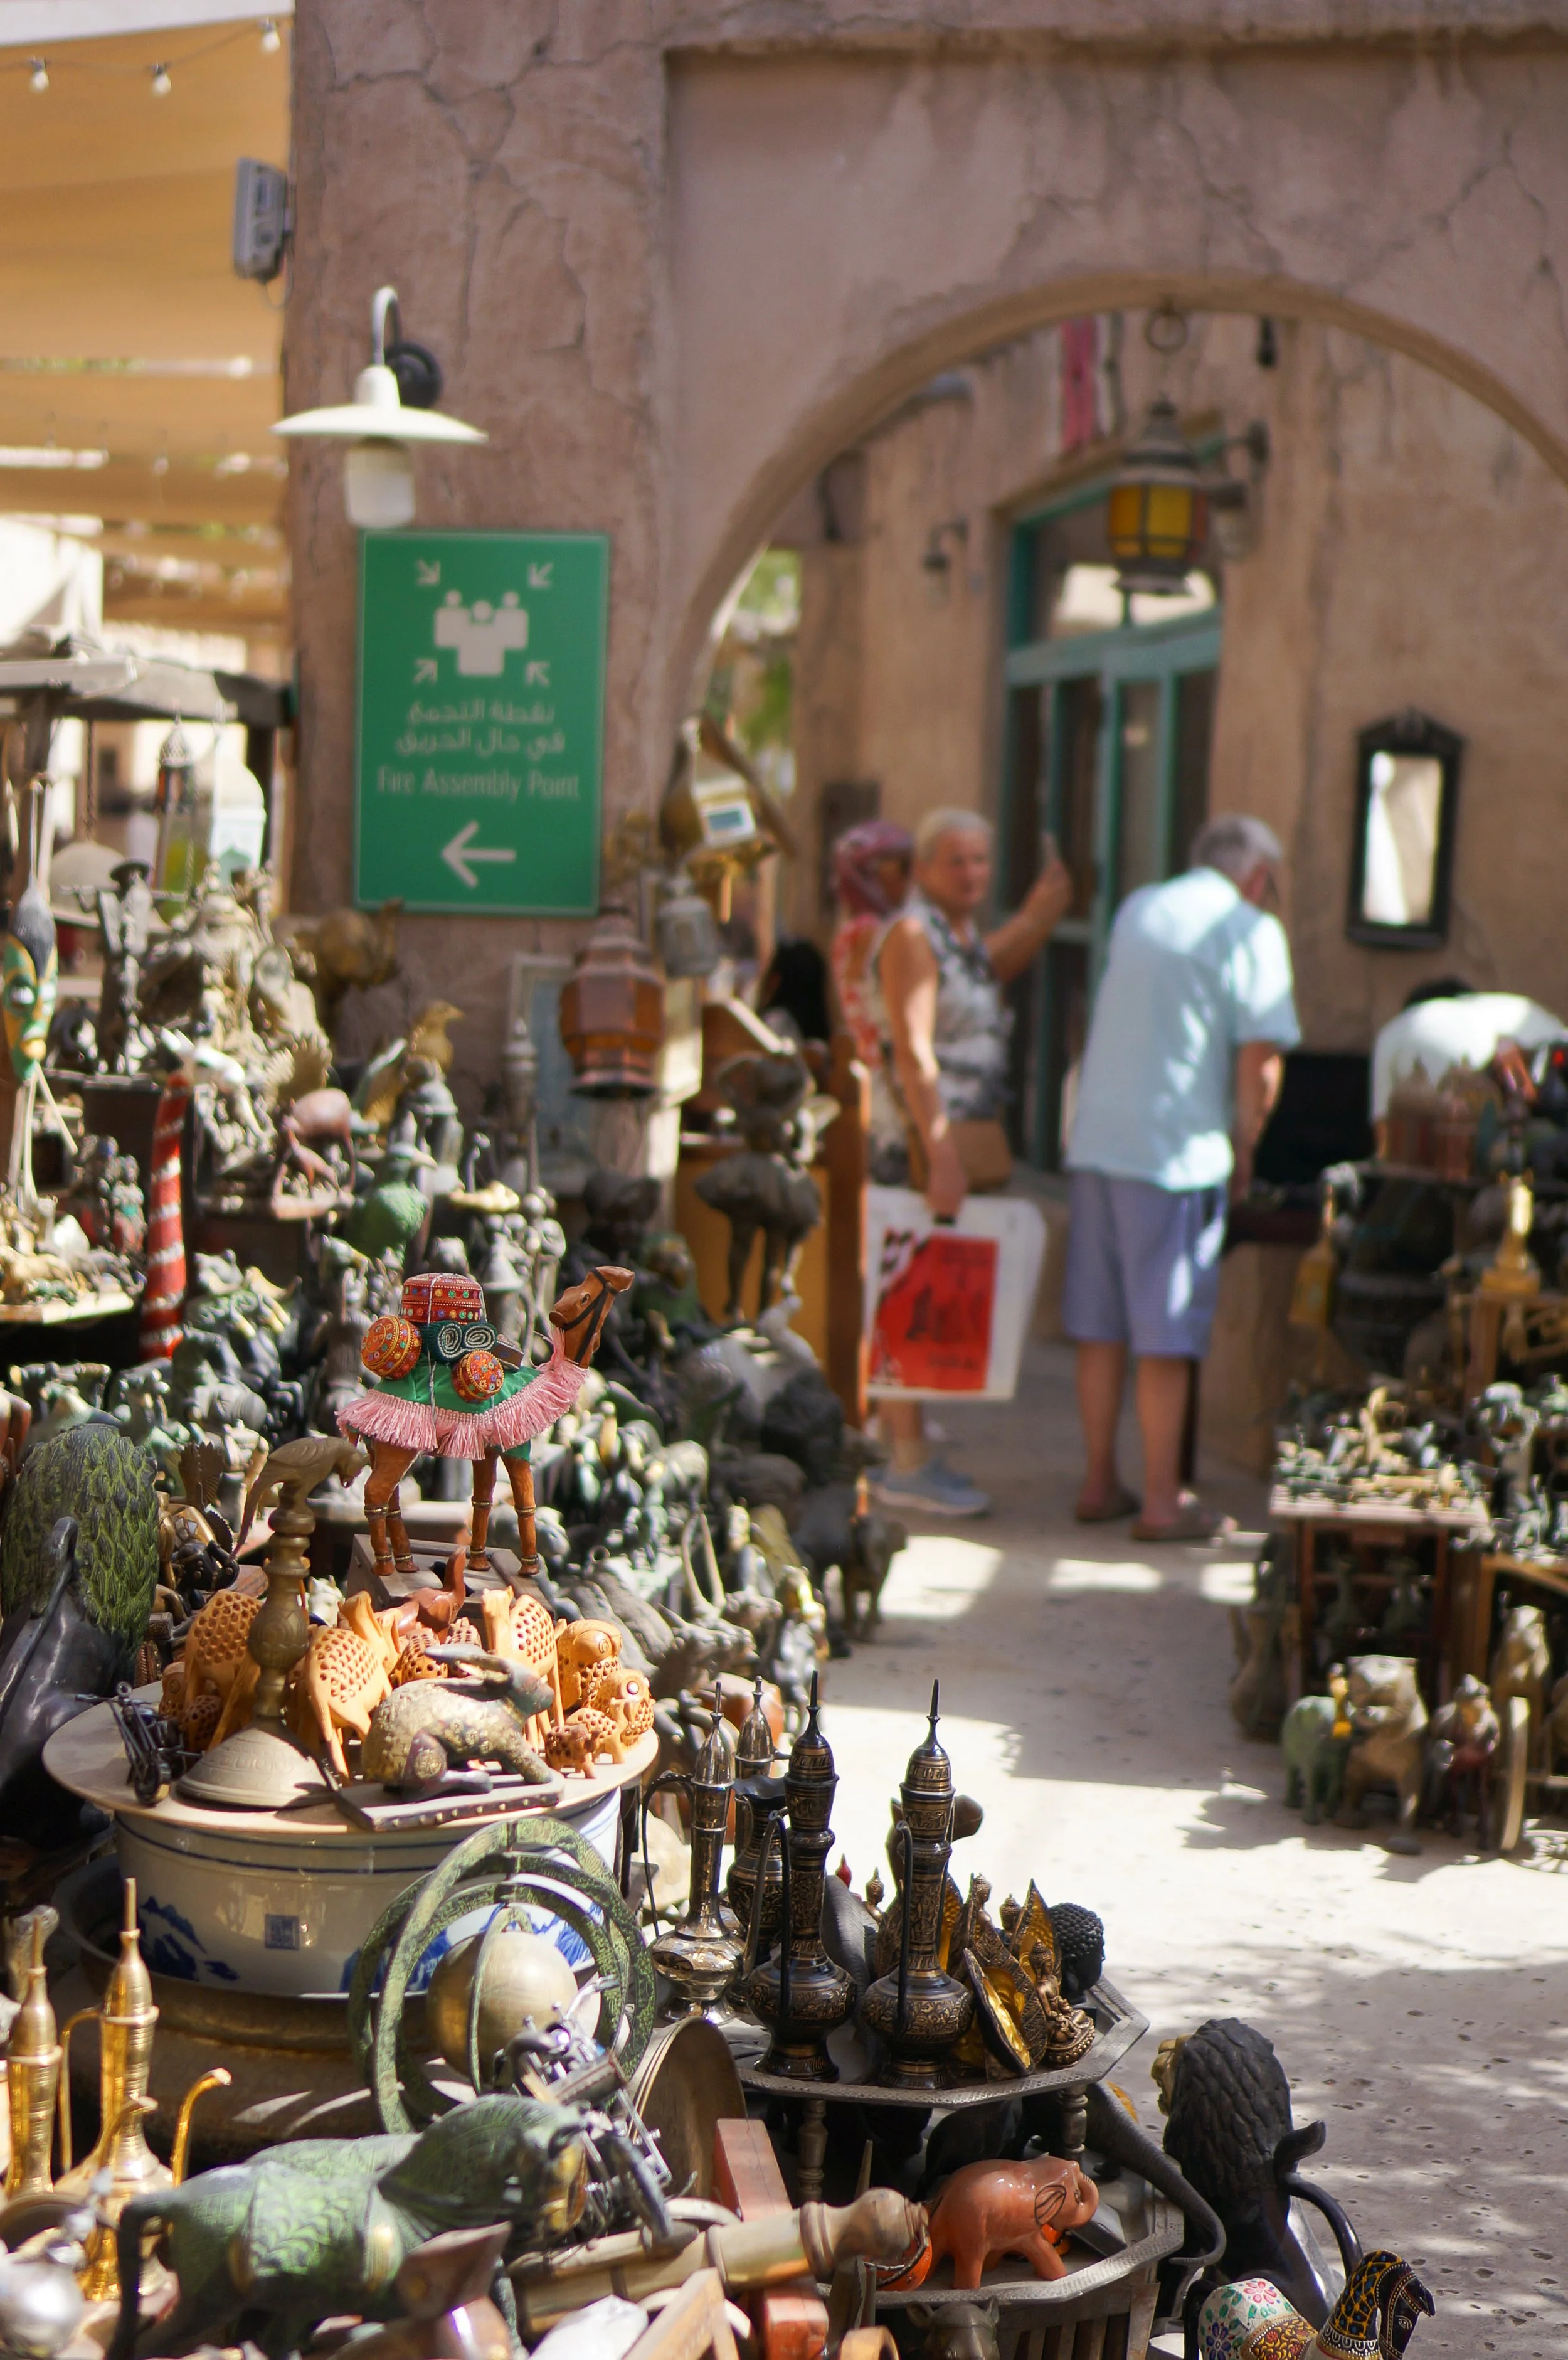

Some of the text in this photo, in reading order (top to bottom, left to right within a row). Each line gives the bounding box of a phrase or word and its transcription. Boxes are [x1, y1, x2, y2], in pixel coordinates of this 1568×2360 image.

[406, 699, 556, 726] نقطة التجمع
[395, 726, 566, 760] في حال الحريق
[376, 765, 581, 804] Fire Assembly Point
